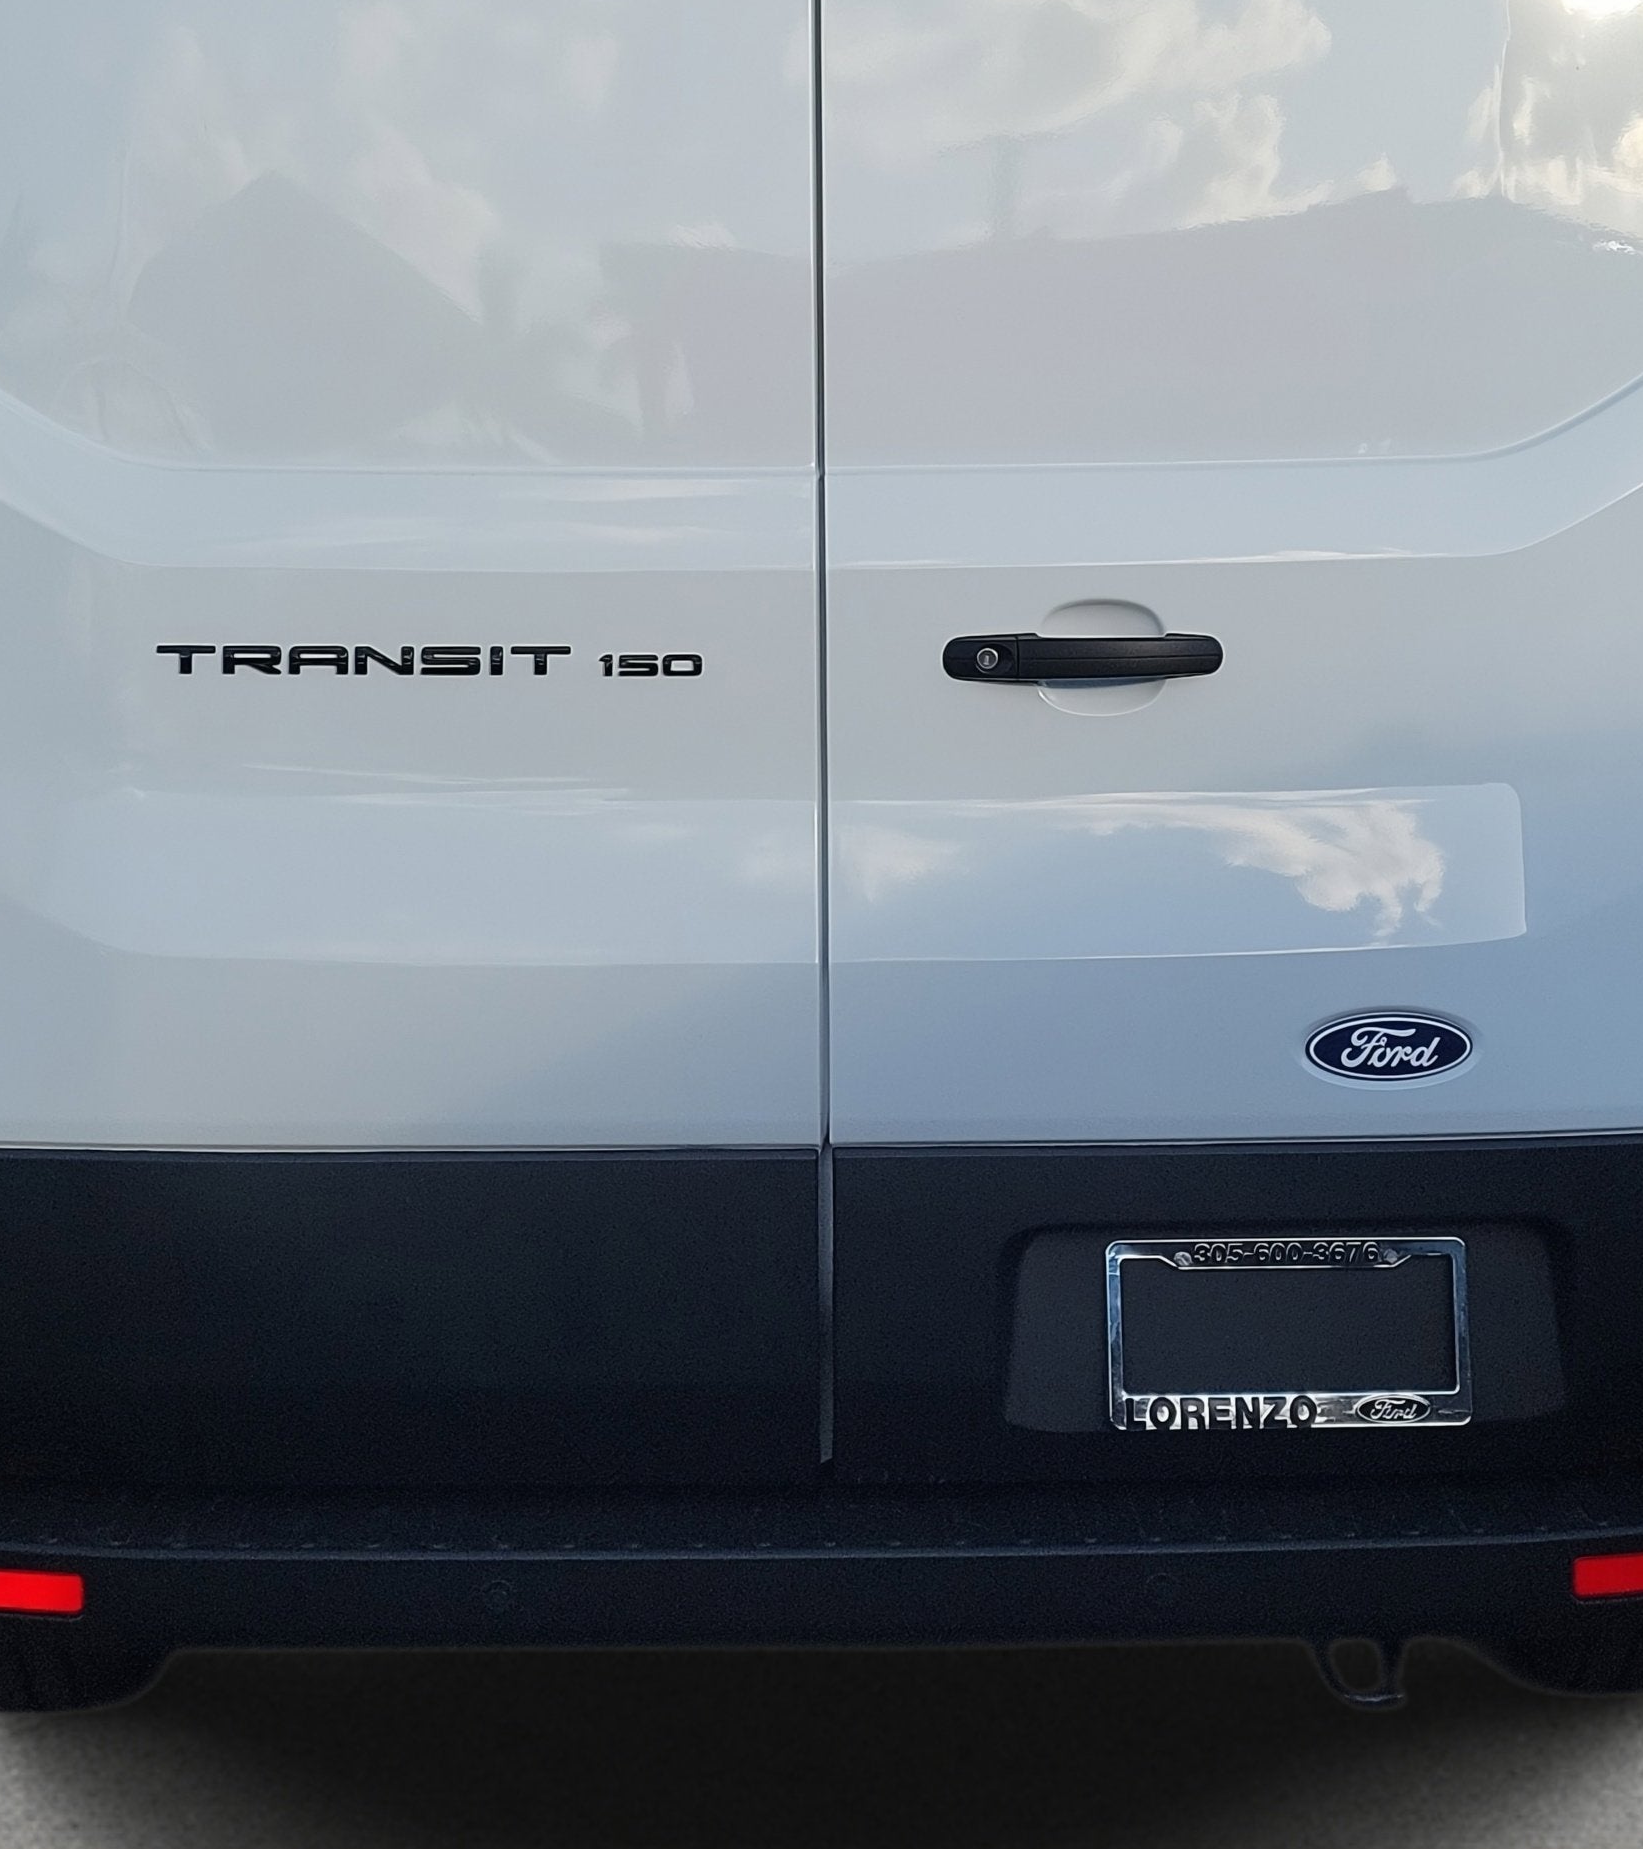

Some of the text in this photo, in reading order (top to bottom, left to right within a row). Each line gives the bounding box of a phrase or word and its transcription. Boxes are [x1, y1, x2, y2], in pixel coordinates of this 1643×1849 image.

[156, 645, 703, 678] TRANSIT 150
[1340, 1026, 1441, 1068] Ford
[1193, 1240, 1381, 1265] 305-600-3676
[1124, 1395, 1419, 1430] LORENZO Ford
